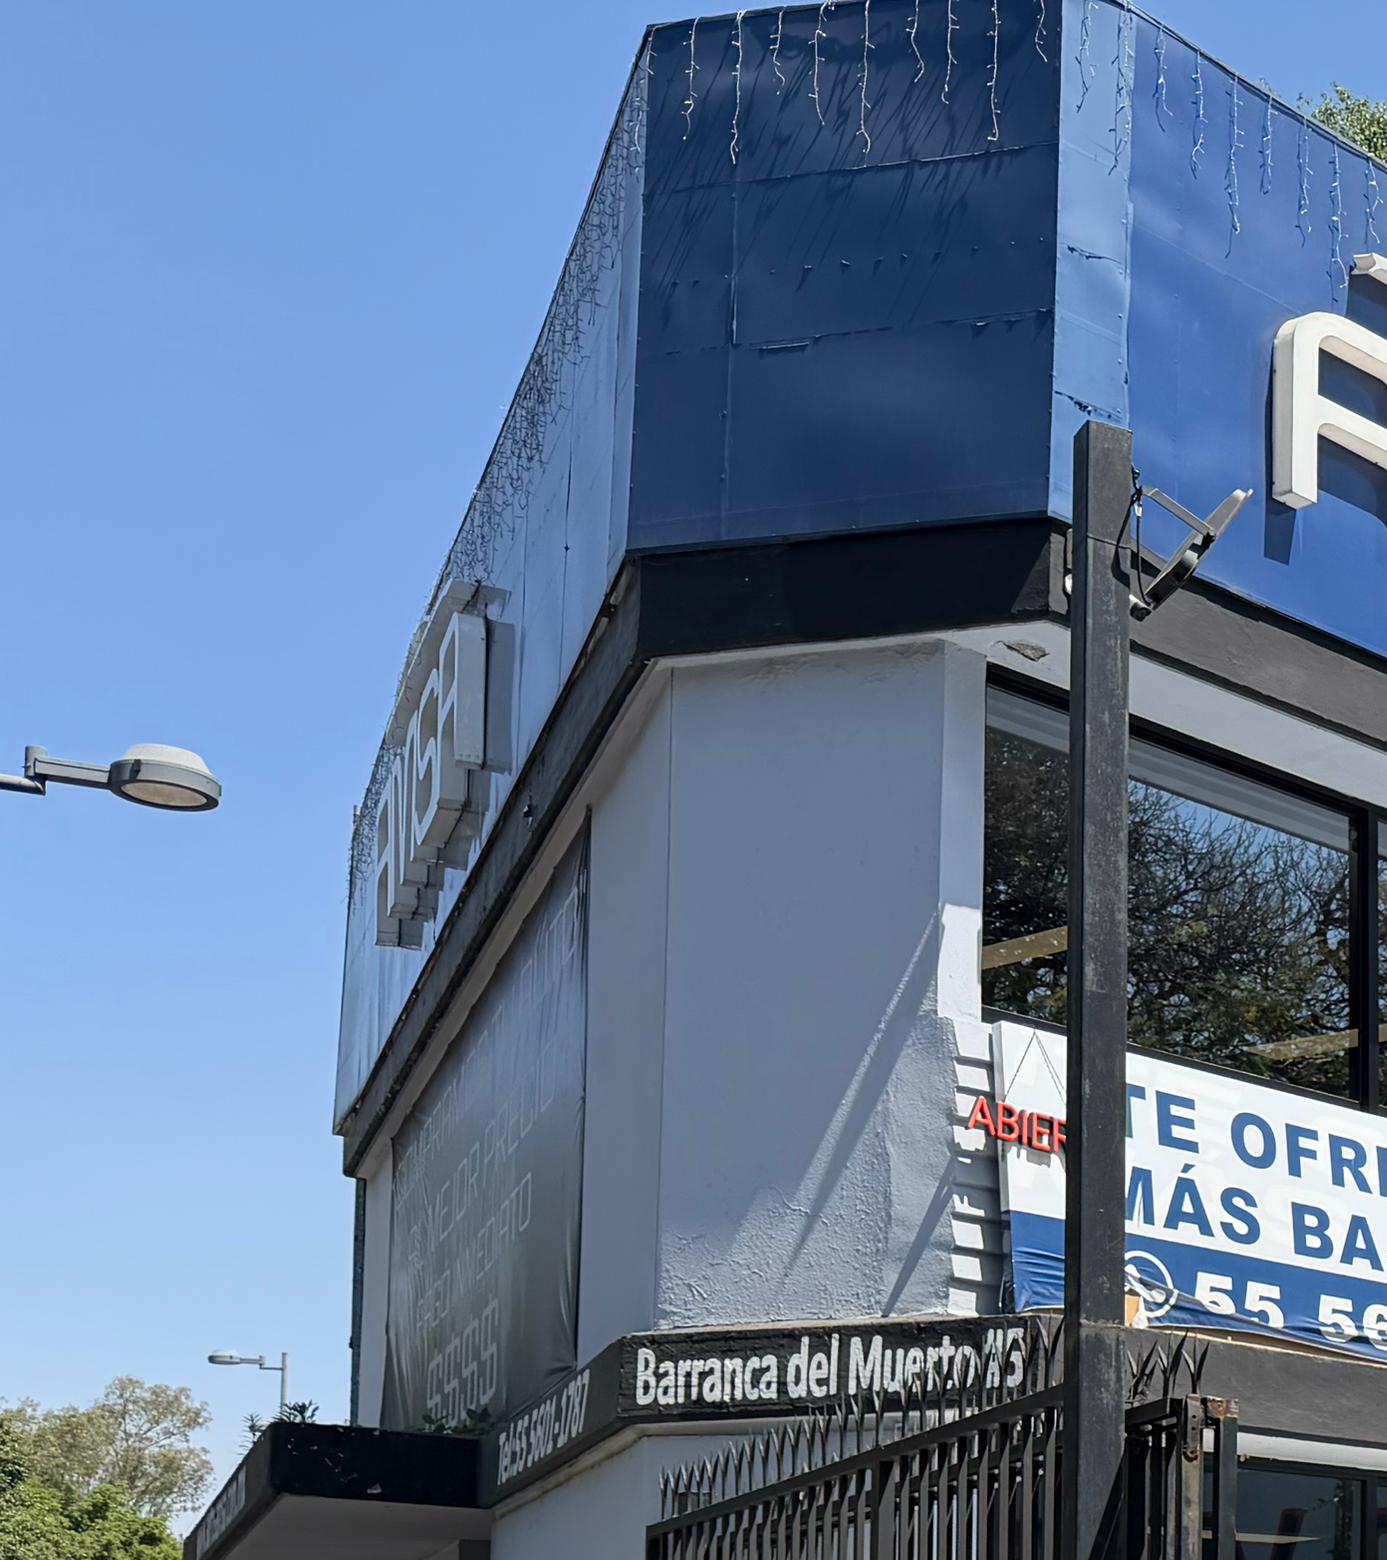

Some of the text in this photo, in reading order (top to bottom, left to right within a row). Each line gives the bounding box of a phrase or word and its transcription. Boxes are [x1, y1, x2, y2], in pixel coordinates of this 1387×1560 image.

[635, 1346, 778, 1406] Barranca
[786, 1334, 840, 1398] del
[849, 1332, 976, 1397] Muerto
